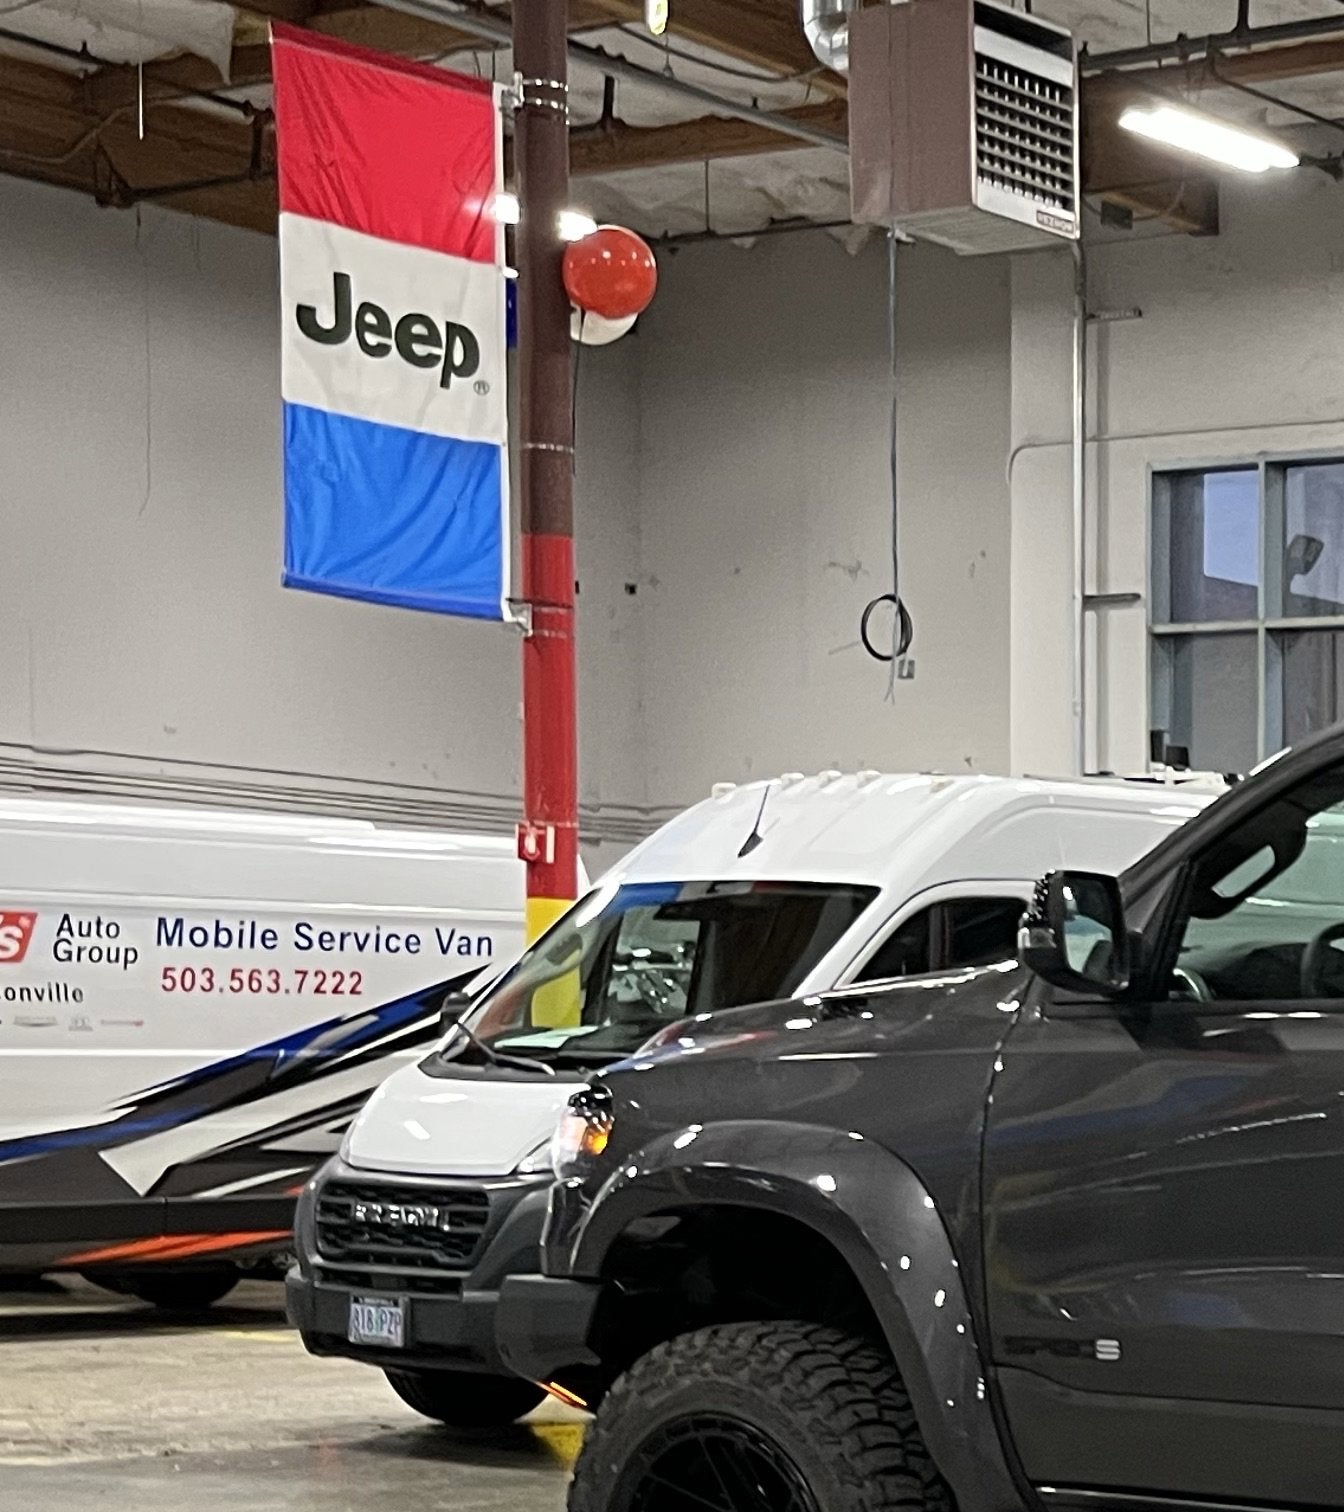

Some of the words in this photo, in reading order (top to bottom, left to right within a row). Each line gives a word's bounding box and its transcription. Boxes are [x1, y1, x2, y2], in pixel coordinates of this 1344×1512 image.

[296, 271, 480, 389] Jeep
[56, 913, 120, 939] Auto
[156, 916, 279, 950] Mobile
[293, 922, 422, 955] Service
[434, 927, 494, 957] Van
[53, 938, 138, 971] Group
[161, 966, 363, 996] 503.563.7222
